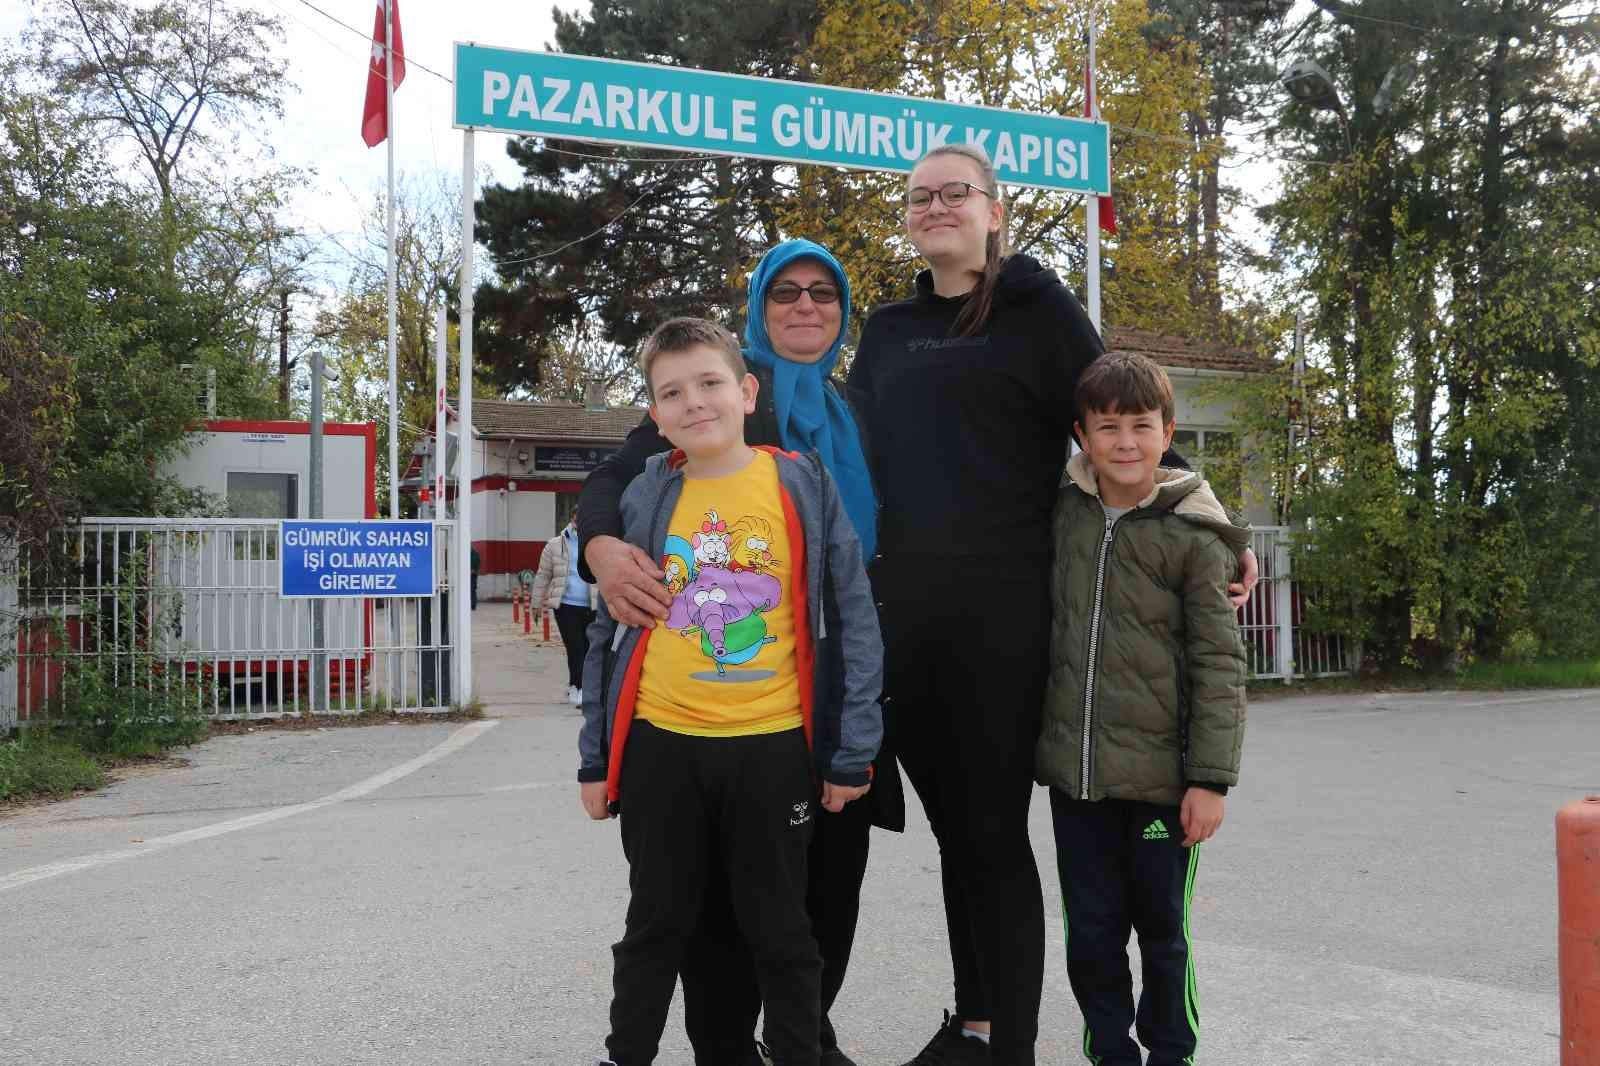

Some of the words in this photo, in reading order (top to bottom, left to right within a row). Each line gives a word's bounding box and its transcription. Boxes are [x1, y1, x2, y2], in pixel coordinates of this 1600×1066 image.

[482, 70, 757, 144] PAZARKULE
[771, 96, 953, 161] GÜMRÜK
[965, 127, 1089, 181] KAPISI
[285, 528, 362, 546] GÜMRÜK
[366, 531, 428, 546] SAHASI
[303, 550, 325, 571] İŞİ
[329, 552, 411, 568] OLMAYAN
[319, 571, 397, 590] GİREMEZ
